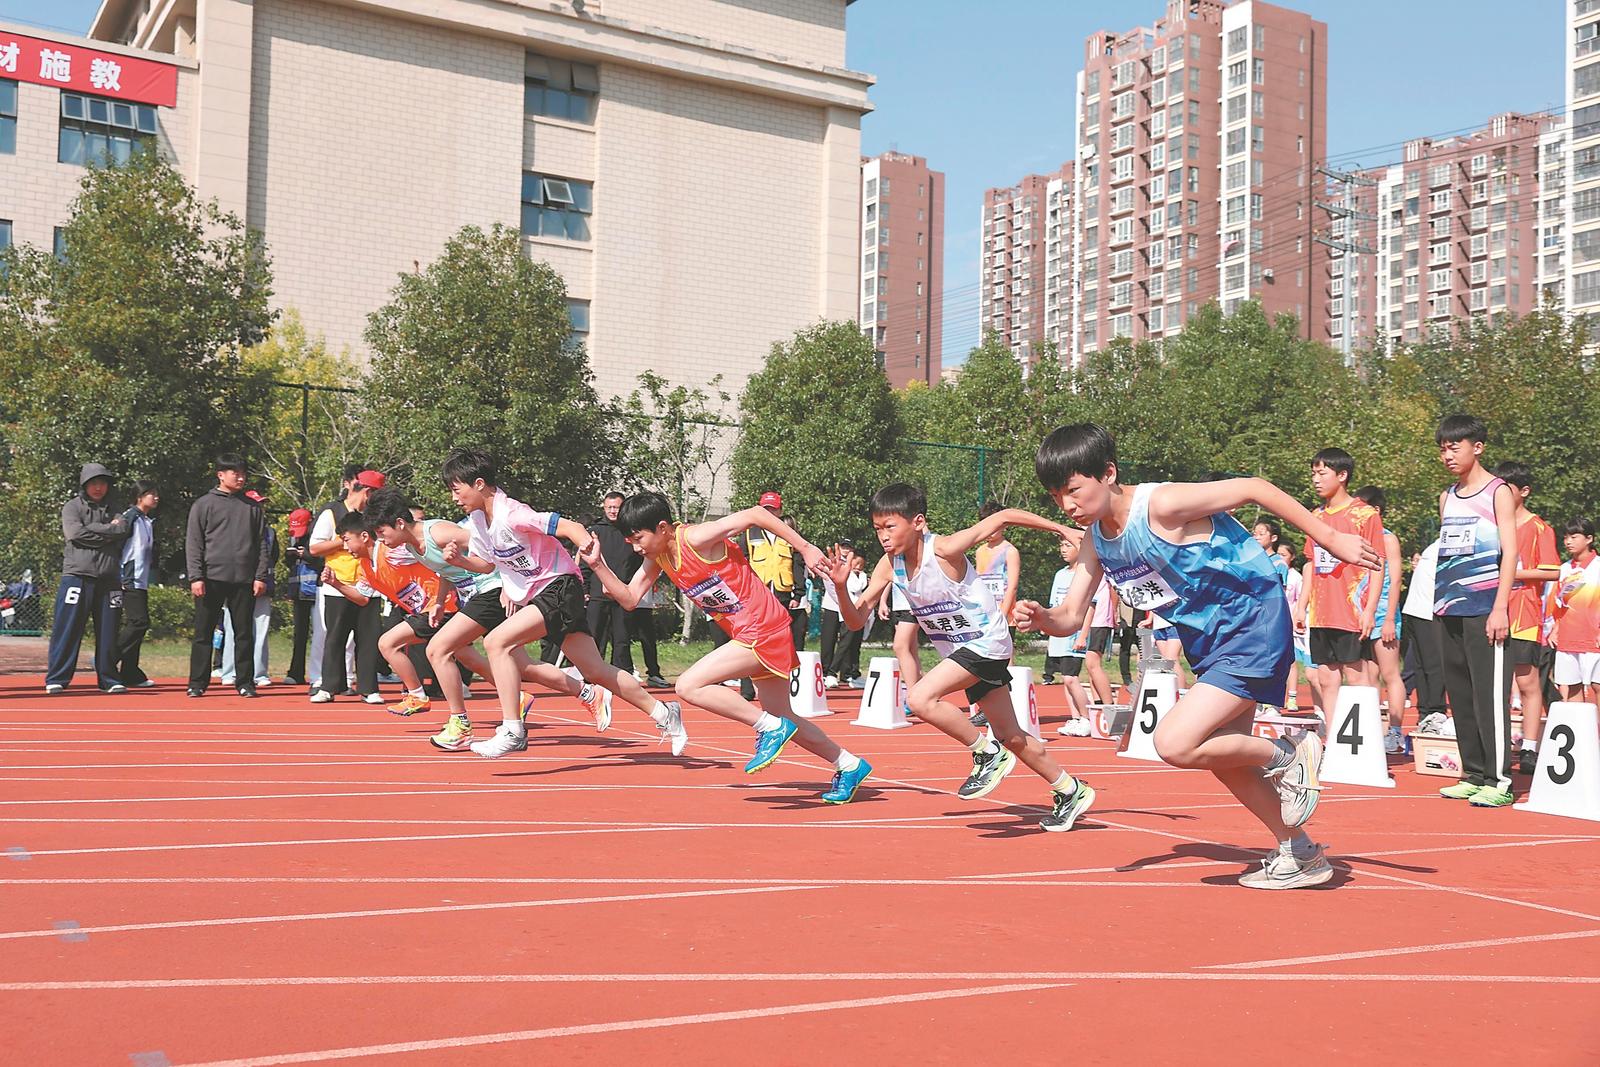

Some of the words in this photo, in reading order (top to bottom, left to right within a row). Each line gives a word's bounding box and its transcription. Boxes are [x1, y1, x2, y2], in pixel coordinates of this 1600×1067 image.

[0, 41, 121, 91] 材施教
[65, 587, 81, 604] 6
[790, 667, 800, 697] 8
[815, 662, 823, 697] 8
[868, 671, 880, 707] 7
[893, 671, 900, 707] 7
[1029, 683, 1036, 725] 6
[1140, 689, 1157, 734] 5
[1337, 703, 1363, 755] 4
[1547, 724, 1576, 785] 3
